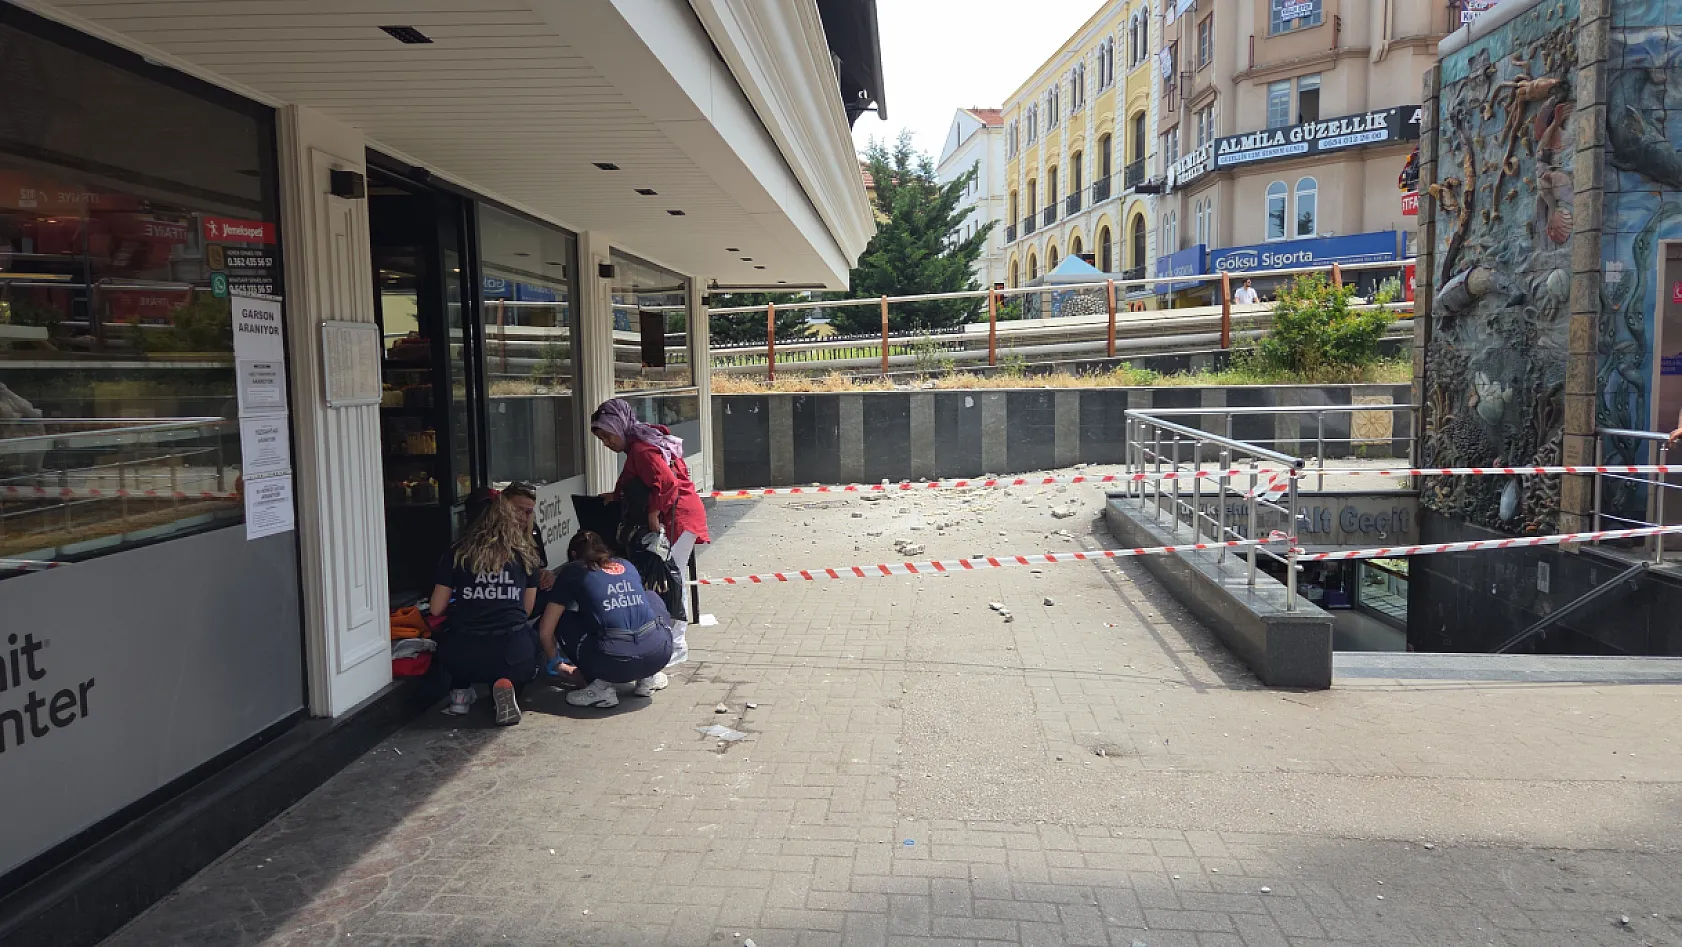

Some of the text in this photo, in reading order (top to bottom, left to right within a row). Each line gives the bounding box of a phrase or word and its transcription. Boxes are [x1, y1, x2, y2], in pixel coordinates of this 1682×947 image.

[1218, 112, 1388, 154] ALMİLA GÜZELLİK
[1216, 254, 1258, 270] Göksu
[1262, 250, 1313, 267] Sigorta
[241, 309, 274, 321] GARSON
[239, 323, 279, 335] ARANIYOR
[539, 495, 562, 523] Simit
[1297, 504, 1411, 539] Alt Geçit
[462, 584, 522, 601] SAĞLIK
[606, 580, 635, 595] ACİL
[602, 593, 645, 612] SAĞLIK
[0, 632, 48, 693] it
[0, 677, 95, 755] nter
